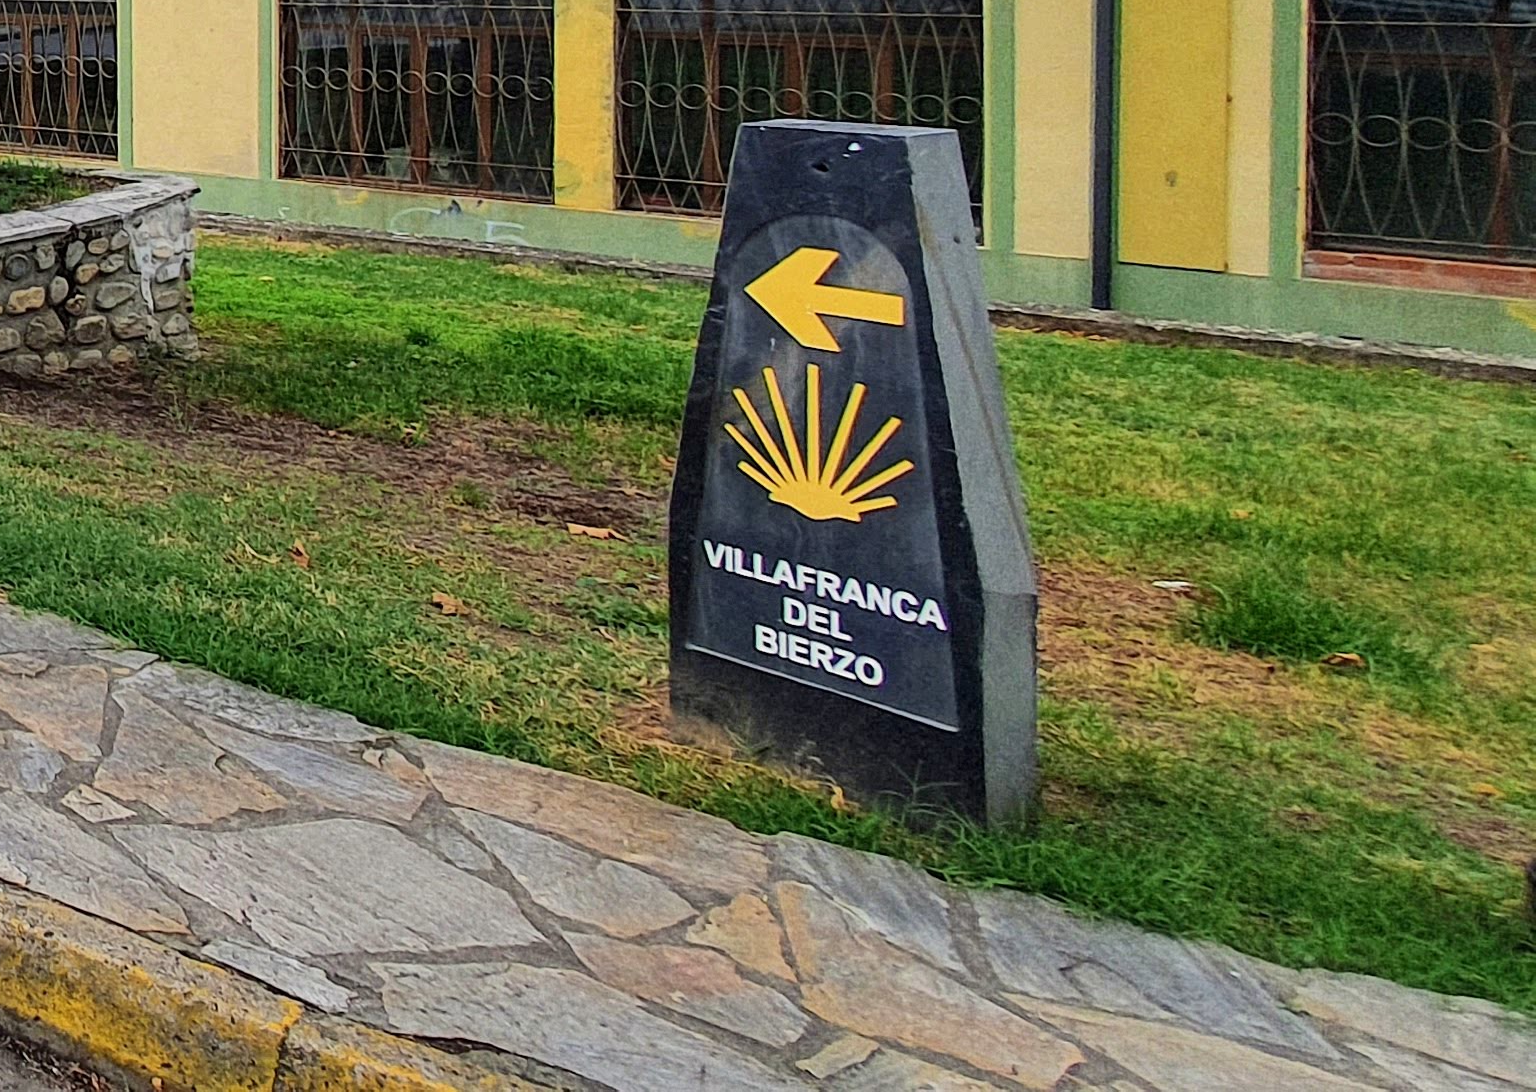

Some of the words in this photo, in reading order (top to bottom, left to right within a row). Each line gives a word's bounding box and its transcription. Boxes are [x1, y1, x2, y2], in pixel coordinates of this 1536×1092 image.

[703, 539, 948, 631] VILLAFRANCA
[783, 596, 853, 642] DEL
[754, 624, 884, 687] BIERZO
